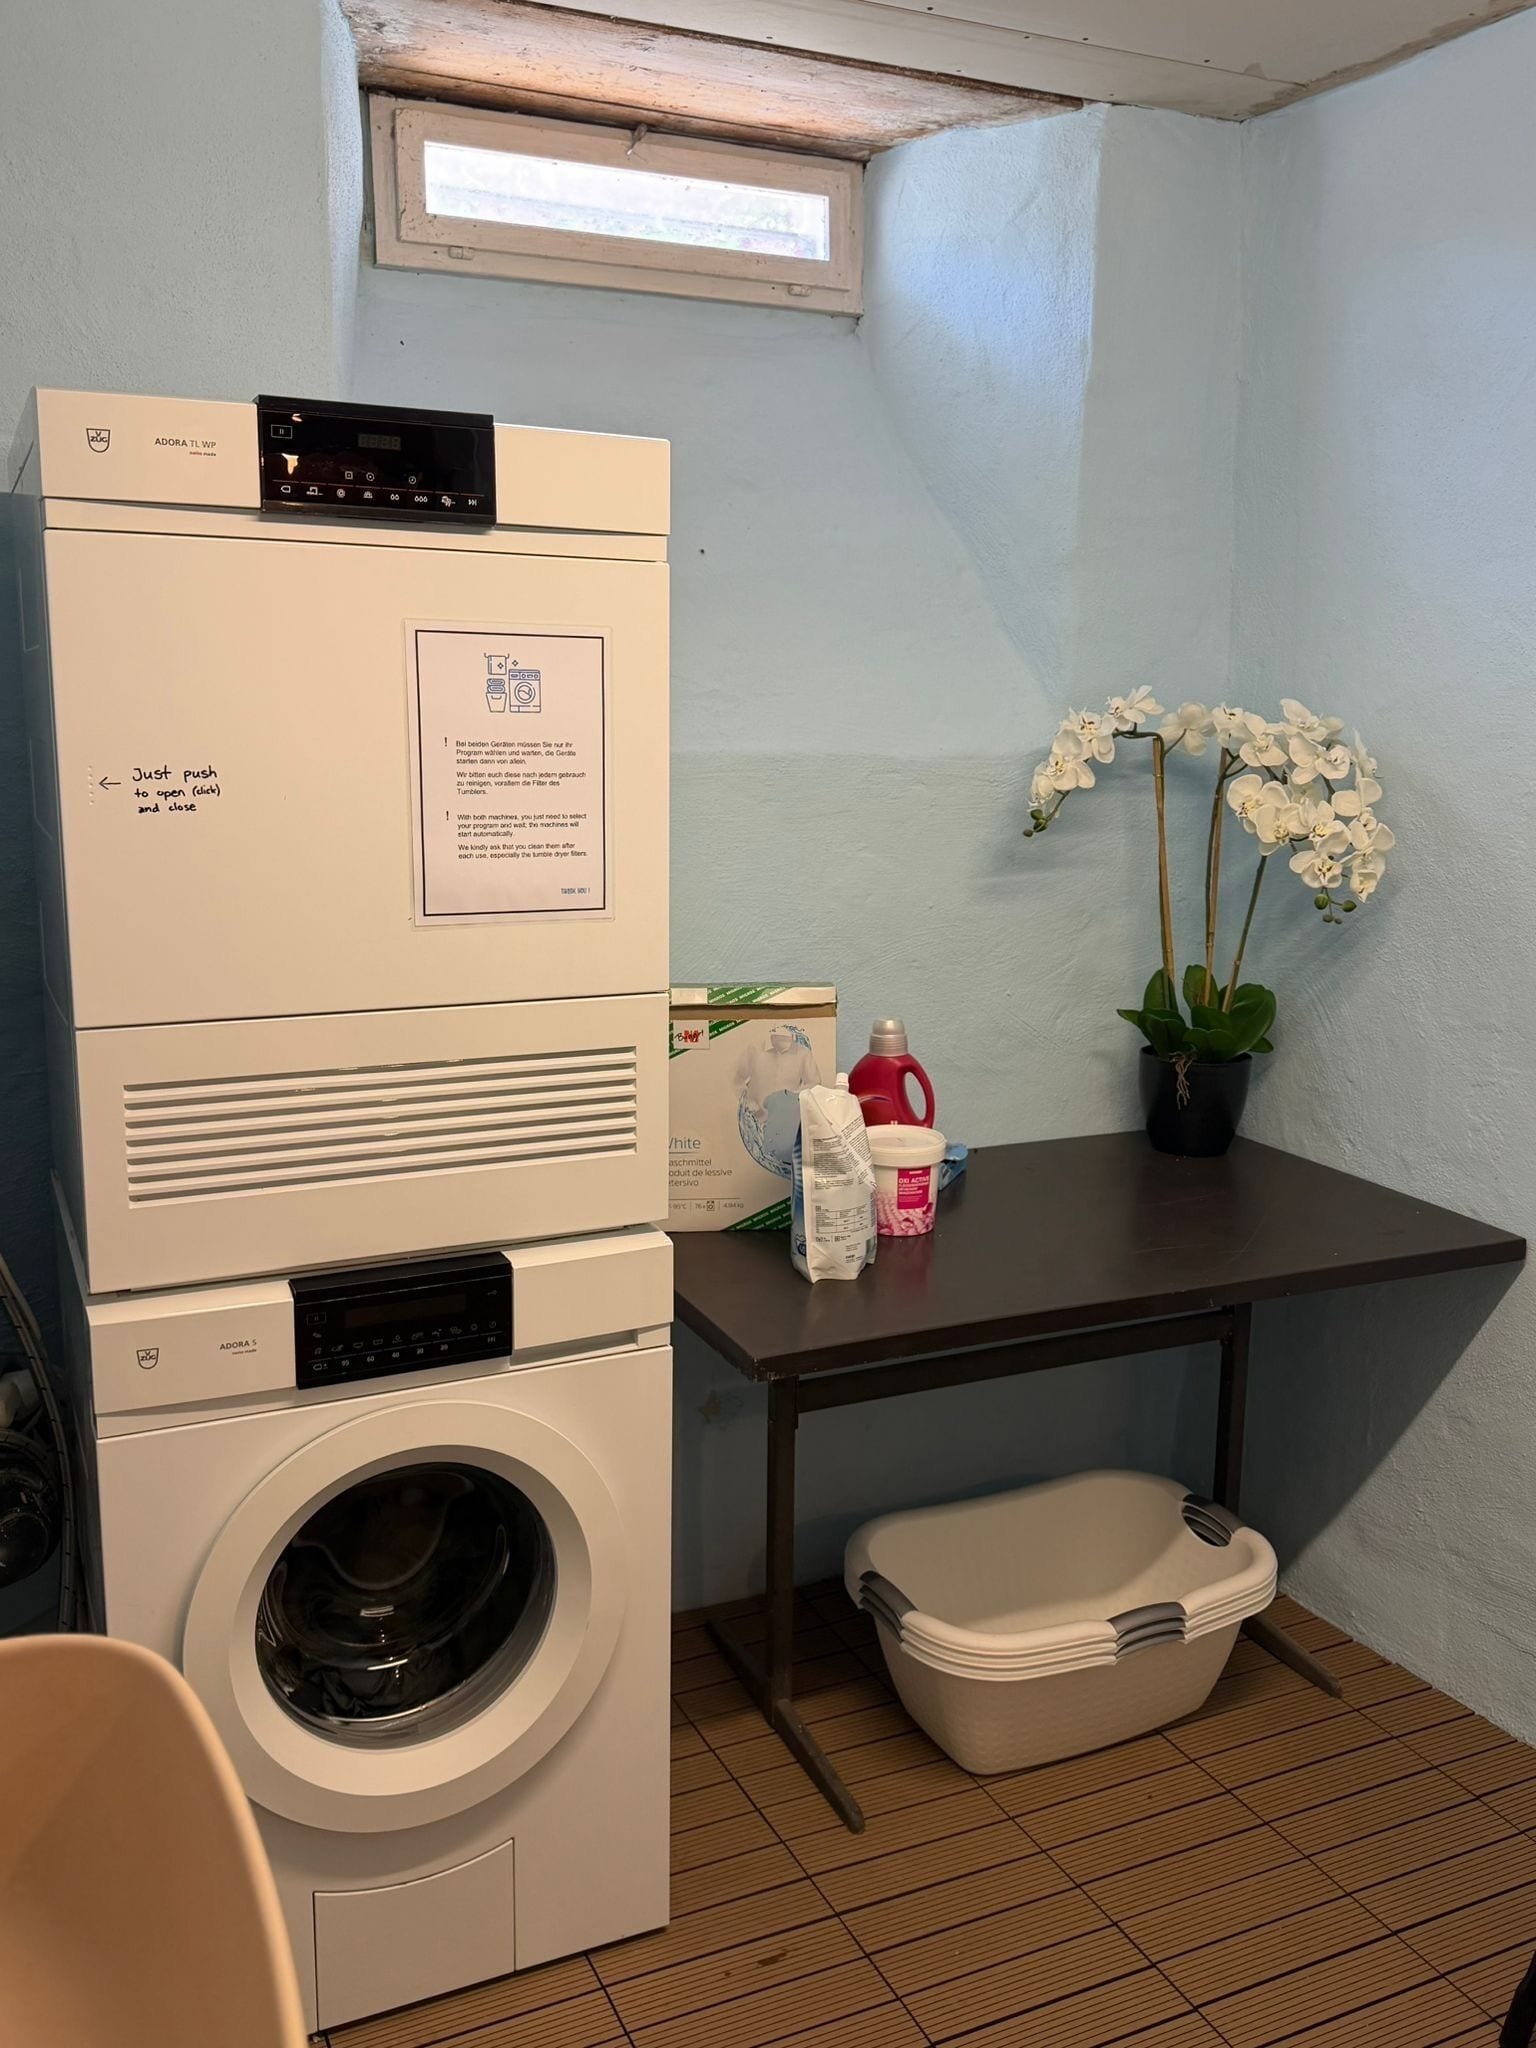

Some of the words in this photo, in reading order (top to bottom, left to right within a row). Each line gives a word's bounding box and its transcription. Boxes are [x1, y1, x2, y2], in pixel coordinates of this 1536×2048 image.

[155, 438, 188, 448] ADORA
[189, 440, 200, 448] TL
[202, 440, 217, 449] WP
[456, 749, 483, 757] Program
[132, 764, 172, 781] Just
[183, 765, 217, 783] push
[134, 788, 149, 798] to
[156, 789, 186, 801] open
[192, 784, 221, 797] (click)
[138, 803, 160, 813] and
[168, 802, 197, 812] close
[490, 851, 520, 859] especially
[669, 1137, 701, 1150] hite
[219, 1340, 250, 1350] ADORA
[366, 1355, 375, 1363] 60
[392, 1351, 400, 1359] 40
